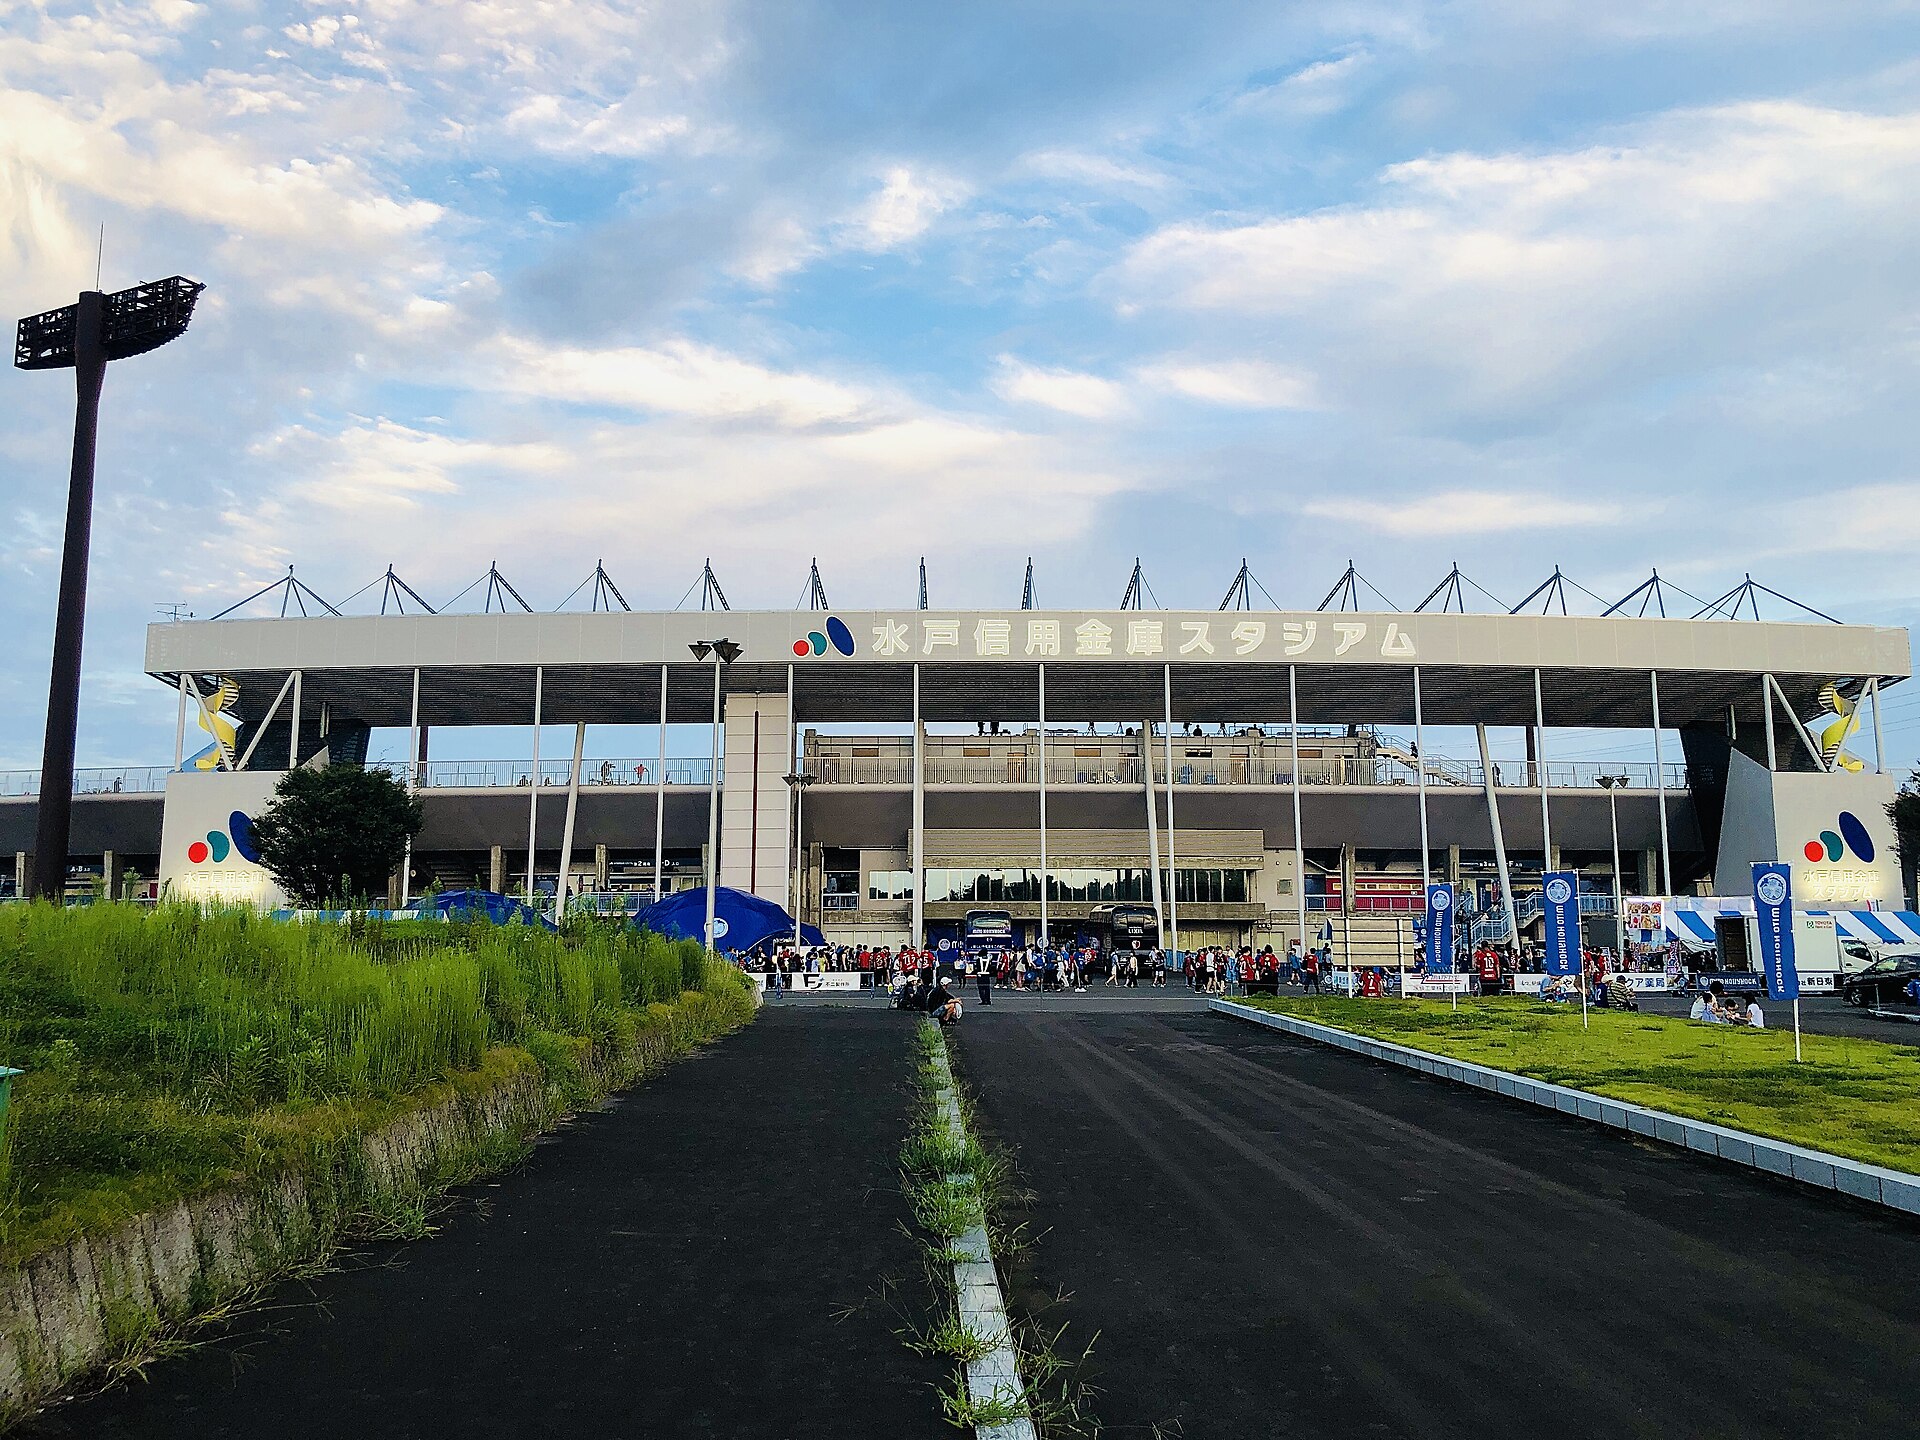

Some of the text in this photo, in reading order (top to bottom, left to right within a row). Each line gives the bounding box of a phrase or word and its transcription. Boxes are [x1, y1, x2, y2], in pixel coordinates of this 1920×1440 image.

[872, 618, 1417, 657] 水戸信用金庫スタジアム
[183, 870, 265, 884] 水戸信用金庫
[1803, 869, 1880, 883] 水戸信用金庫
[1813, 883, 1874, 899] スタジアム
